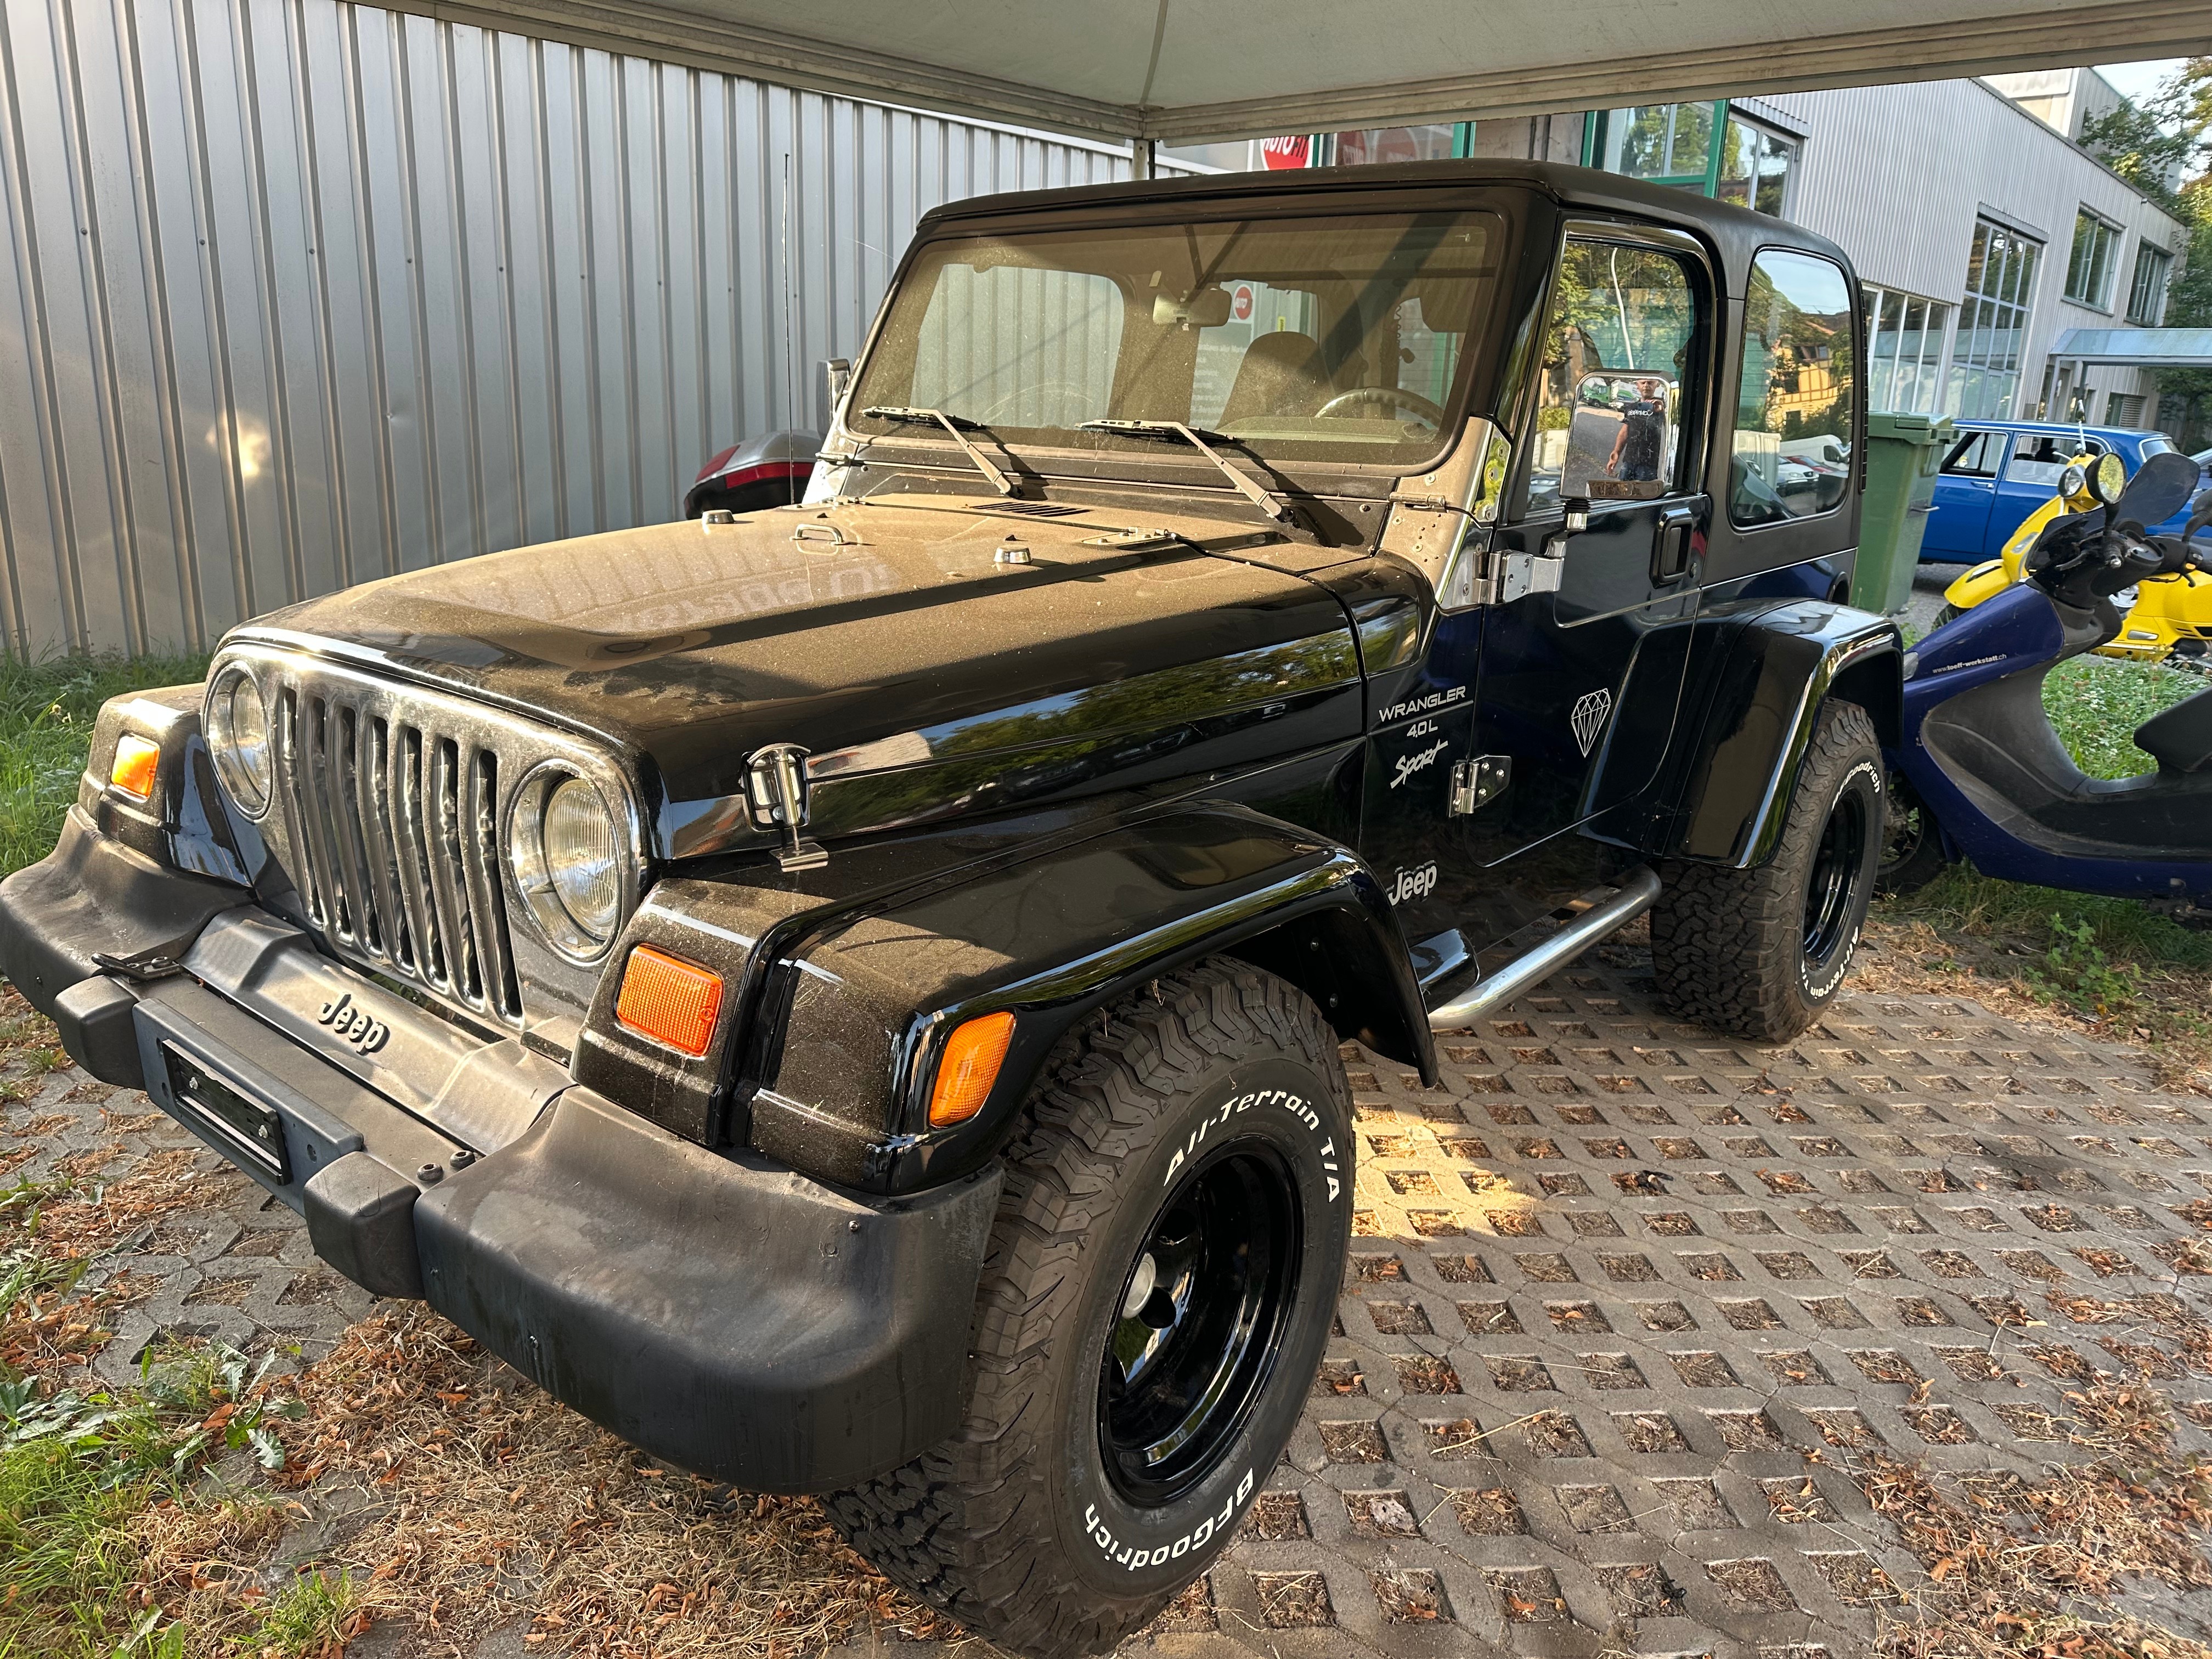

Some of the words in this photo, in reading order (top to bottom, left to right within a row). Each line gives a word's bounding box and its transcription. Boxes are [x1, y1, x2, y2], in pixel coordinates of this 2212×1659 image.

[1932, 654, 2007, 674] www.toeff-werkstatt.ch
[1379, 686, 1466, 722] WRANGLER
[1390, 738, 1448, 789] Sport
[1389, 866, 1437, 906] Jeep
[1810, 926, 1859, 1000] All-Terrain
[317, 993, 387, 1054] Jeep
[1163, 1090, 1320, 1187] All-Terrain
[1085, 1468, 1254, 1572] BFGoodrich
